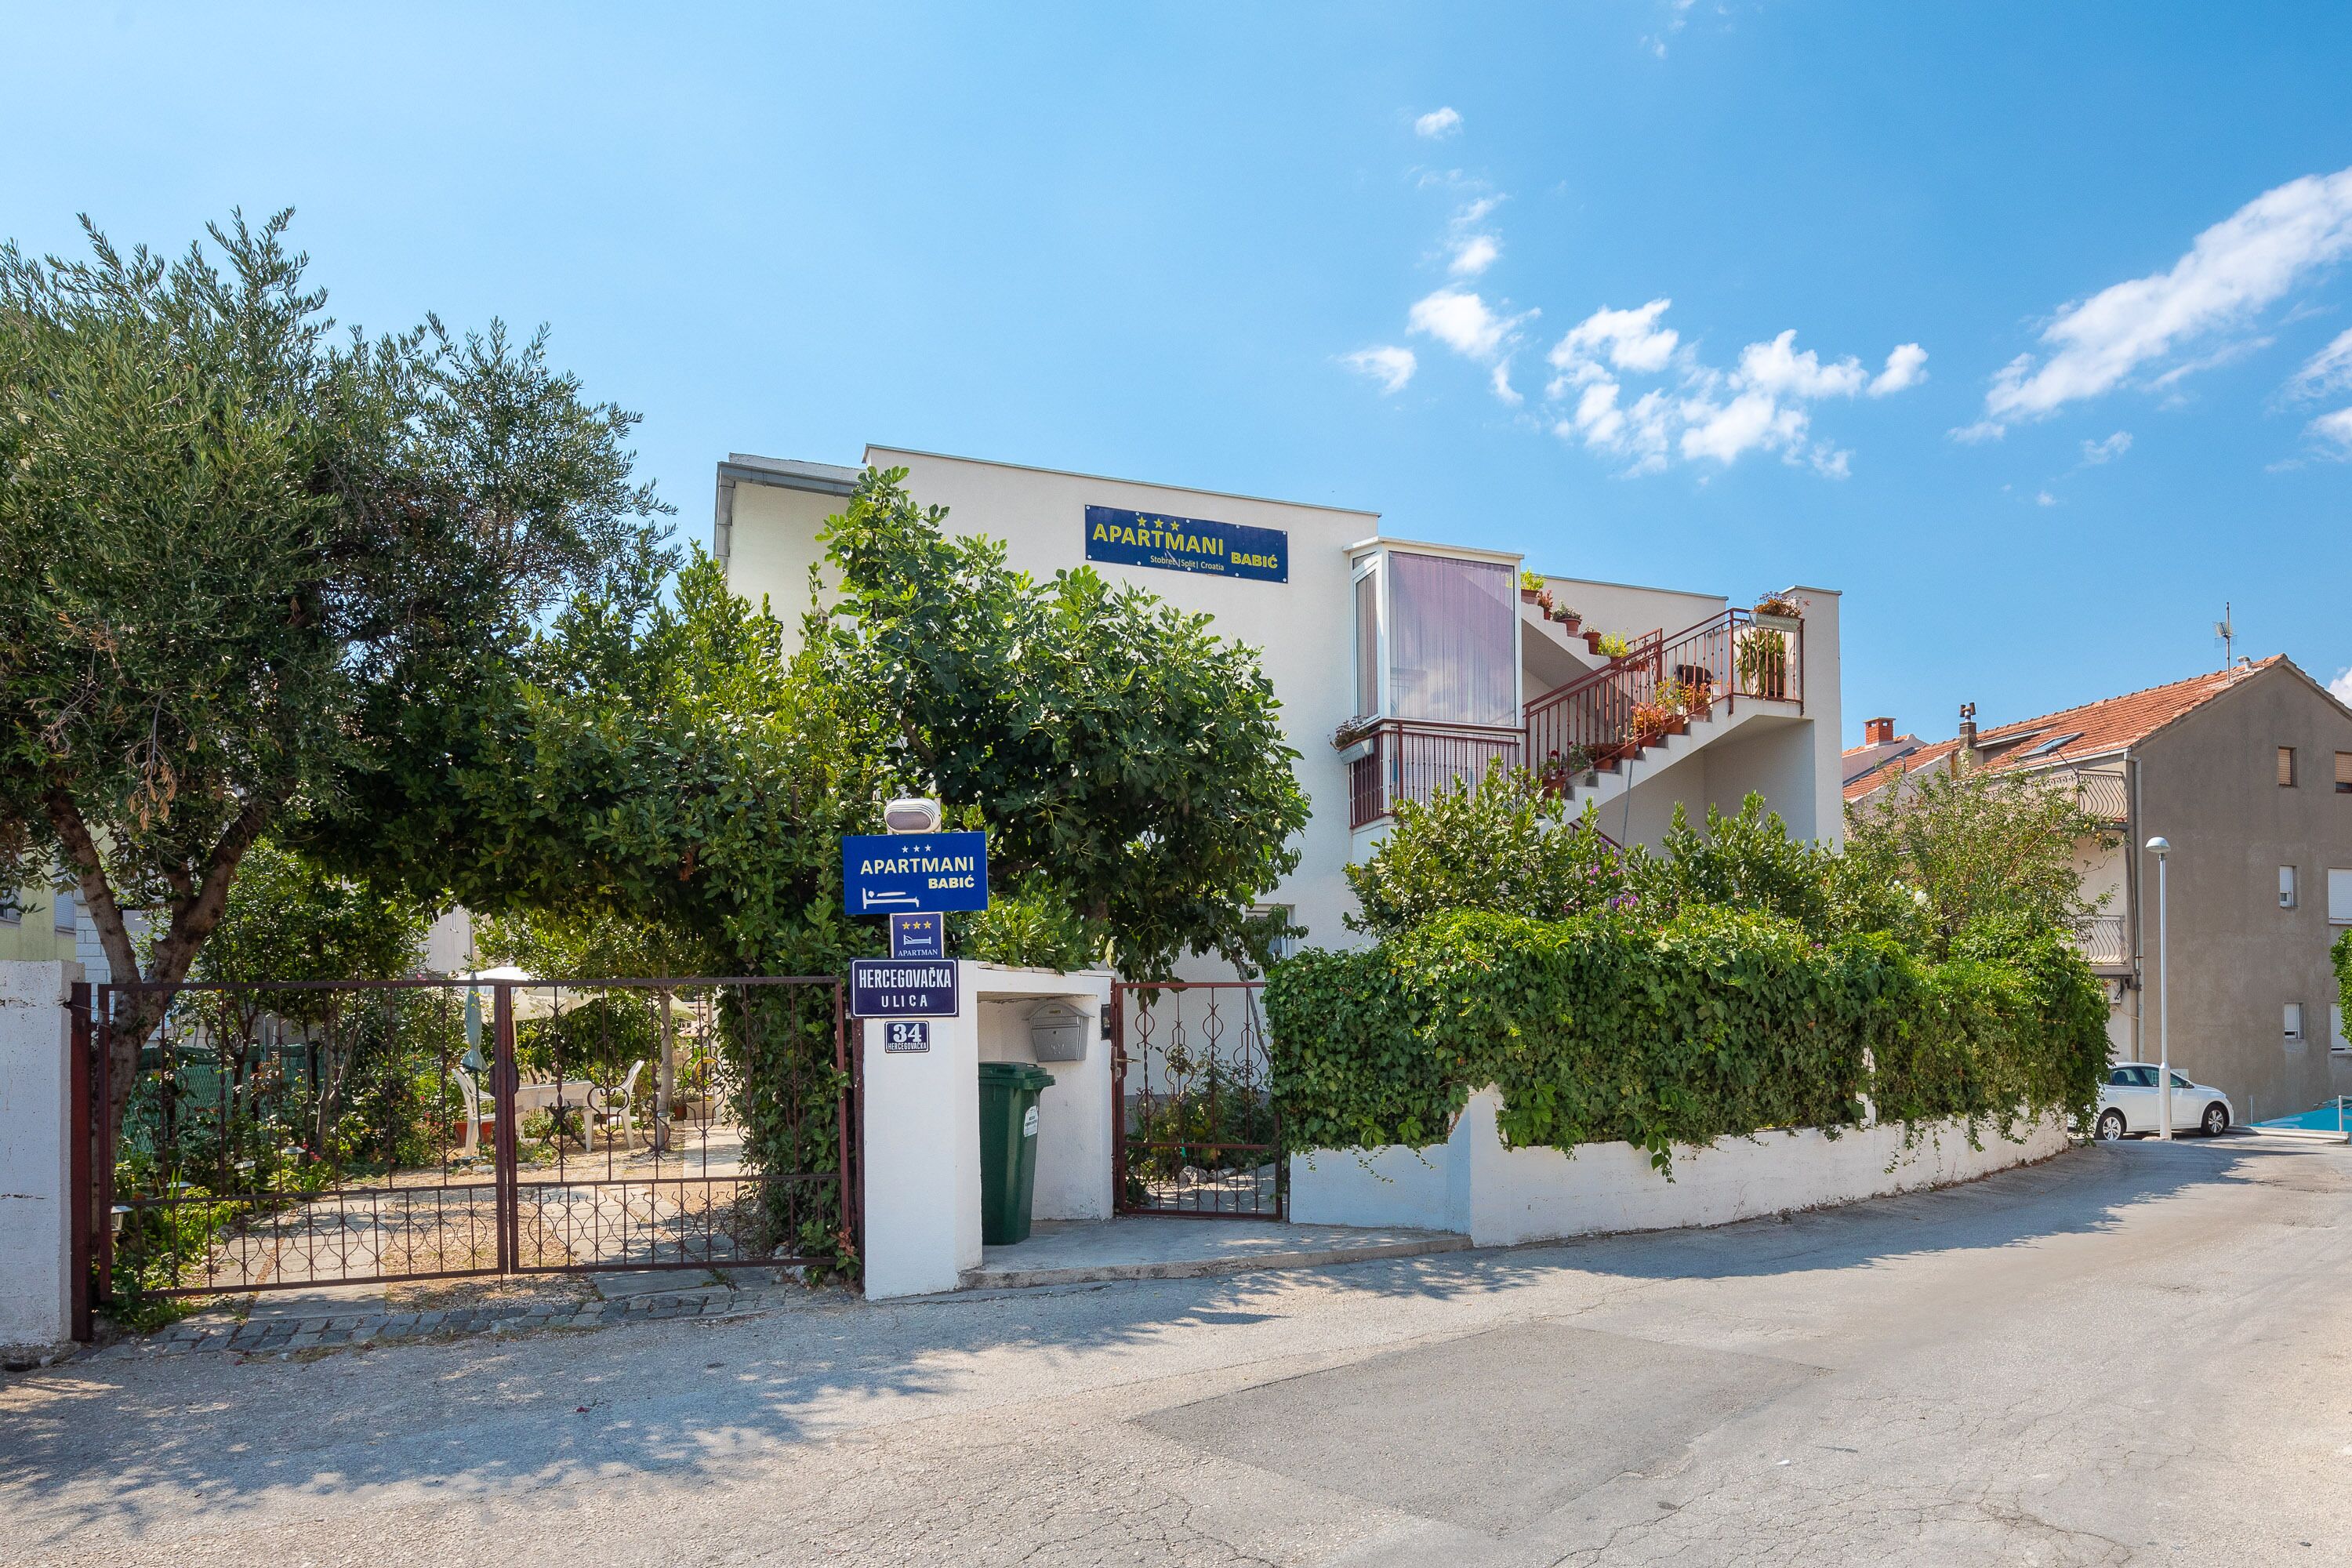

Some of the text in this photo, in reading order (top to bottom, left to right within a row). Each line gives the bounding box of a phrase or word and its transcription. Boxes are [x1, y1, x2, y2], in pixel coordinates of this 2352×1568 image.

[1093, 523, 1278, 569] APARTMANI BABIĆ
[1200, 561, 1225, 572] Croatia
[860, 856, 974, 874] APARTMANI
[928, 874, 975, 889] BABIĆ
[858, 967, 952, 989] HERCEGOVAČKA
[881, 994, 928, 1007] ULICA
[893, 1023, 922, 1043] 34
